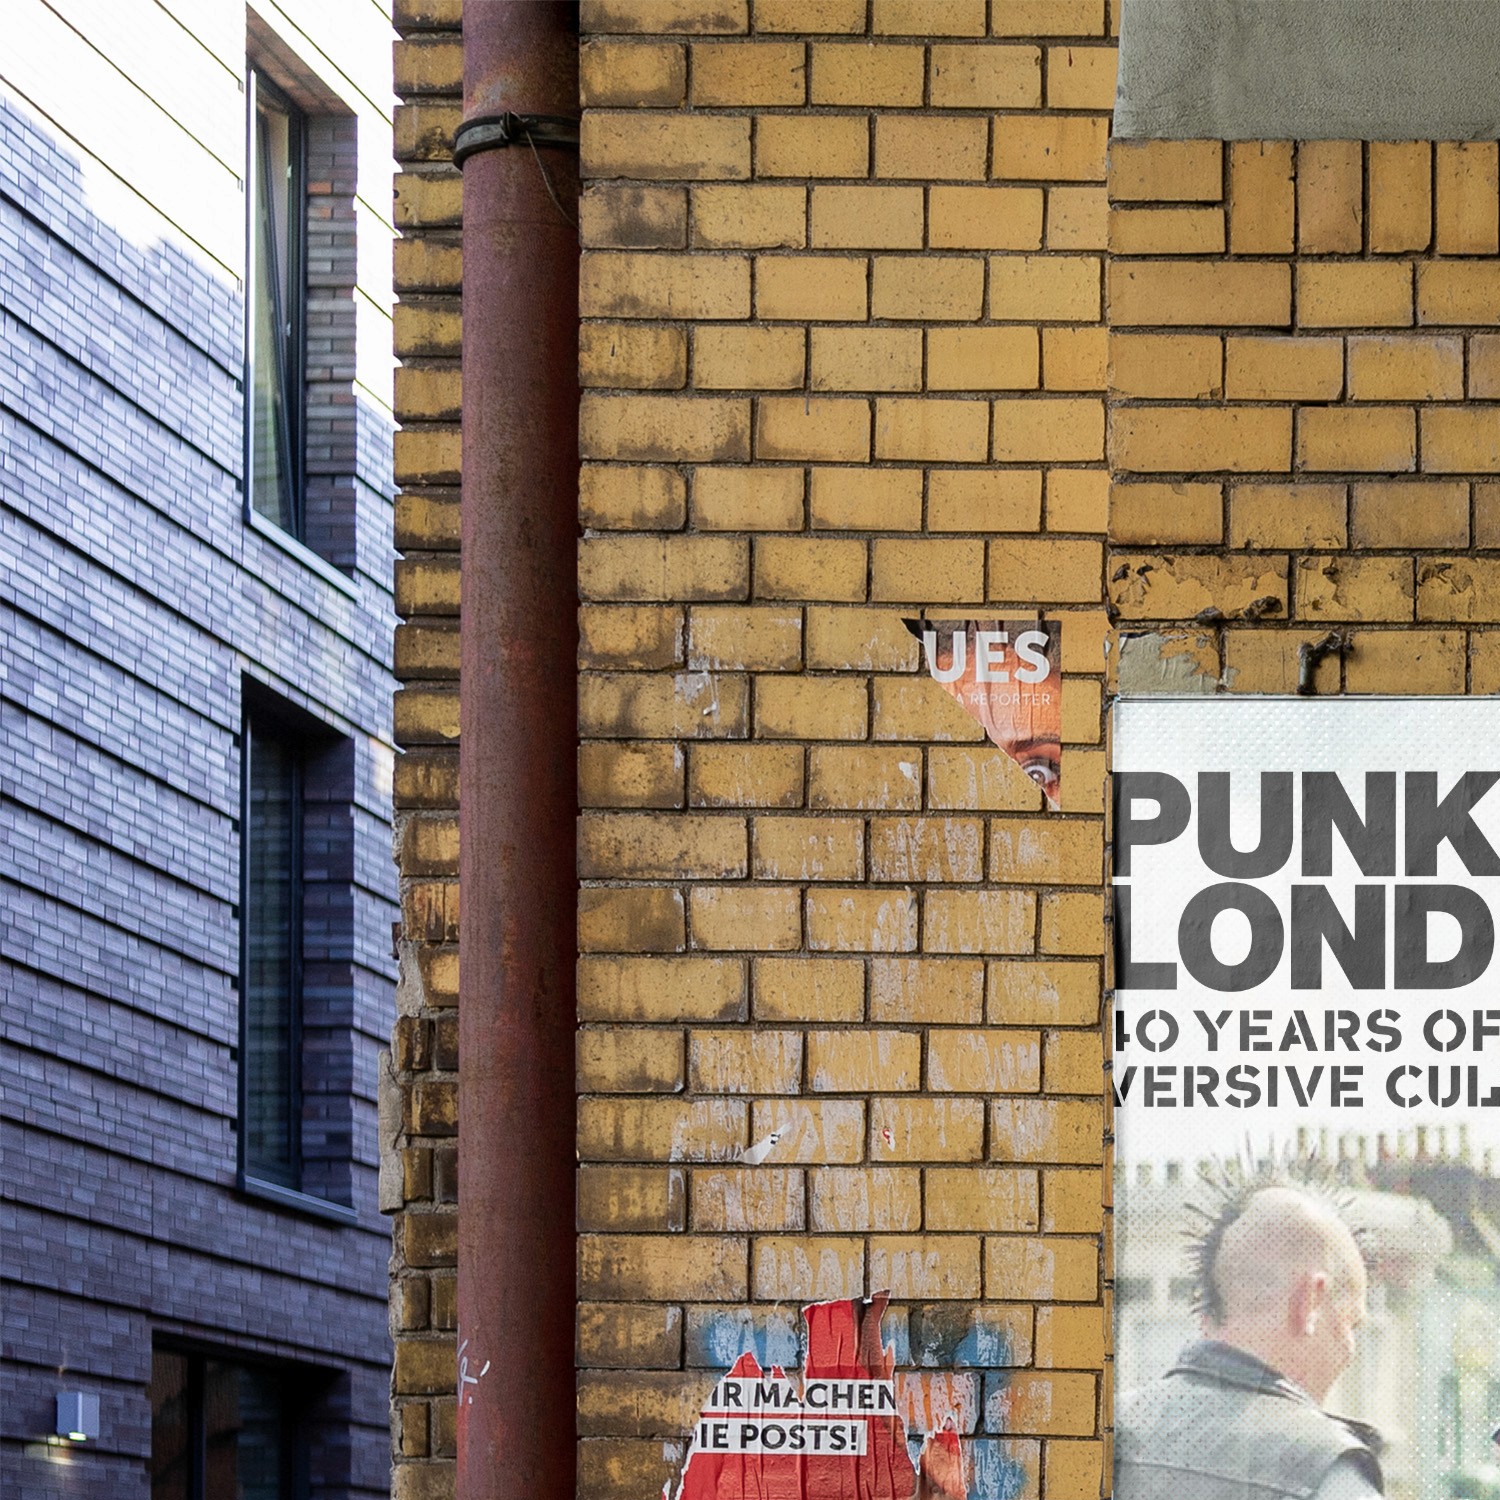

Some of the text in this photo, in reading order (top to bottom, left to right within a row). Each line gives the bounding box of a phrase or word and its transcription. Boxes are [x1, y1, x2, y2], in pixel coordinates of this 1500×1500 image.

[970, 693, 1051, 706] REPORTER
[1193, 1009, 1402, 1053] YEARS
[1112, 1064, 1364, 1109] VERSIVE
[740, 1424, 858, 1450] POSTS!
